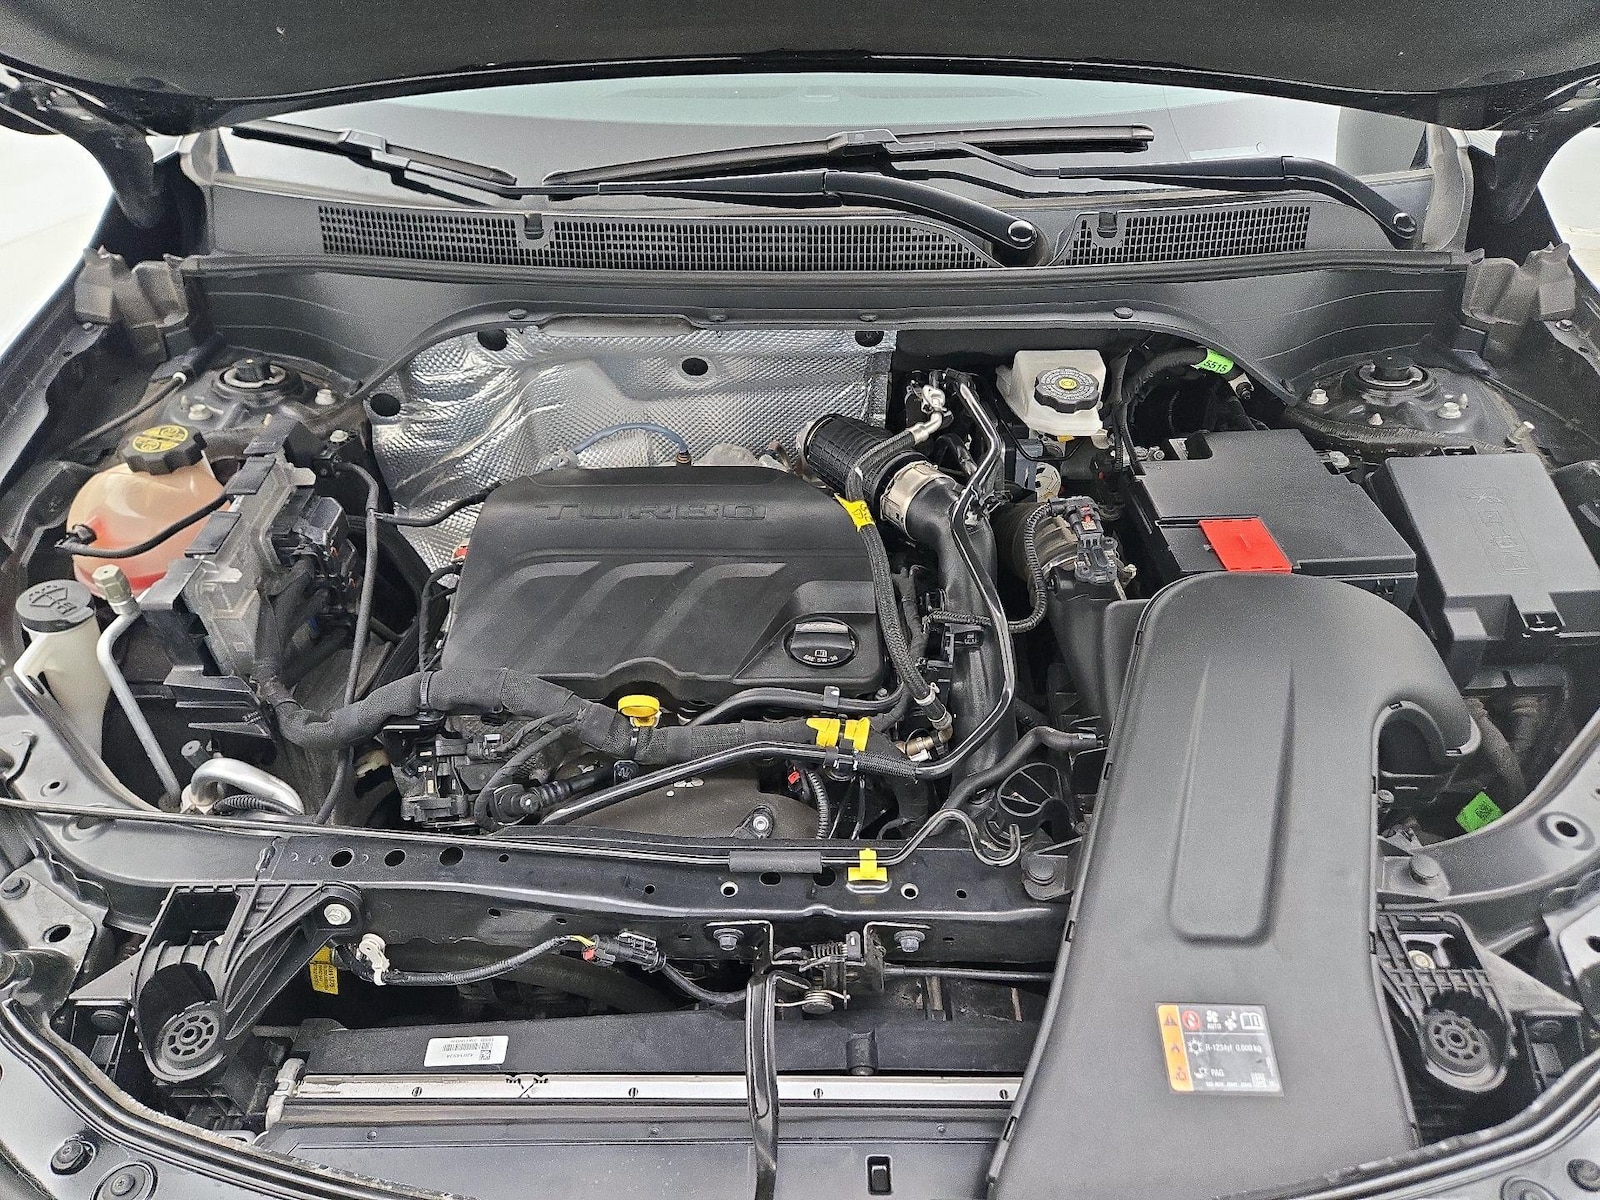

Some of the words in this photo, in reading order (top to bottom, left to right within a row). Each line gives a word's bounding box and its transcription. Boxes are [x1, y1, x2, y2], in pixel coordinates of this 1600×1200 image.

[1204, 360, 1227, 372] 5515
[535, 504, 767, 520] TURBO
[1205, 1043, 1233, 1052] R-1234yf
[1210, 1068, 1225, 1077] PAG
